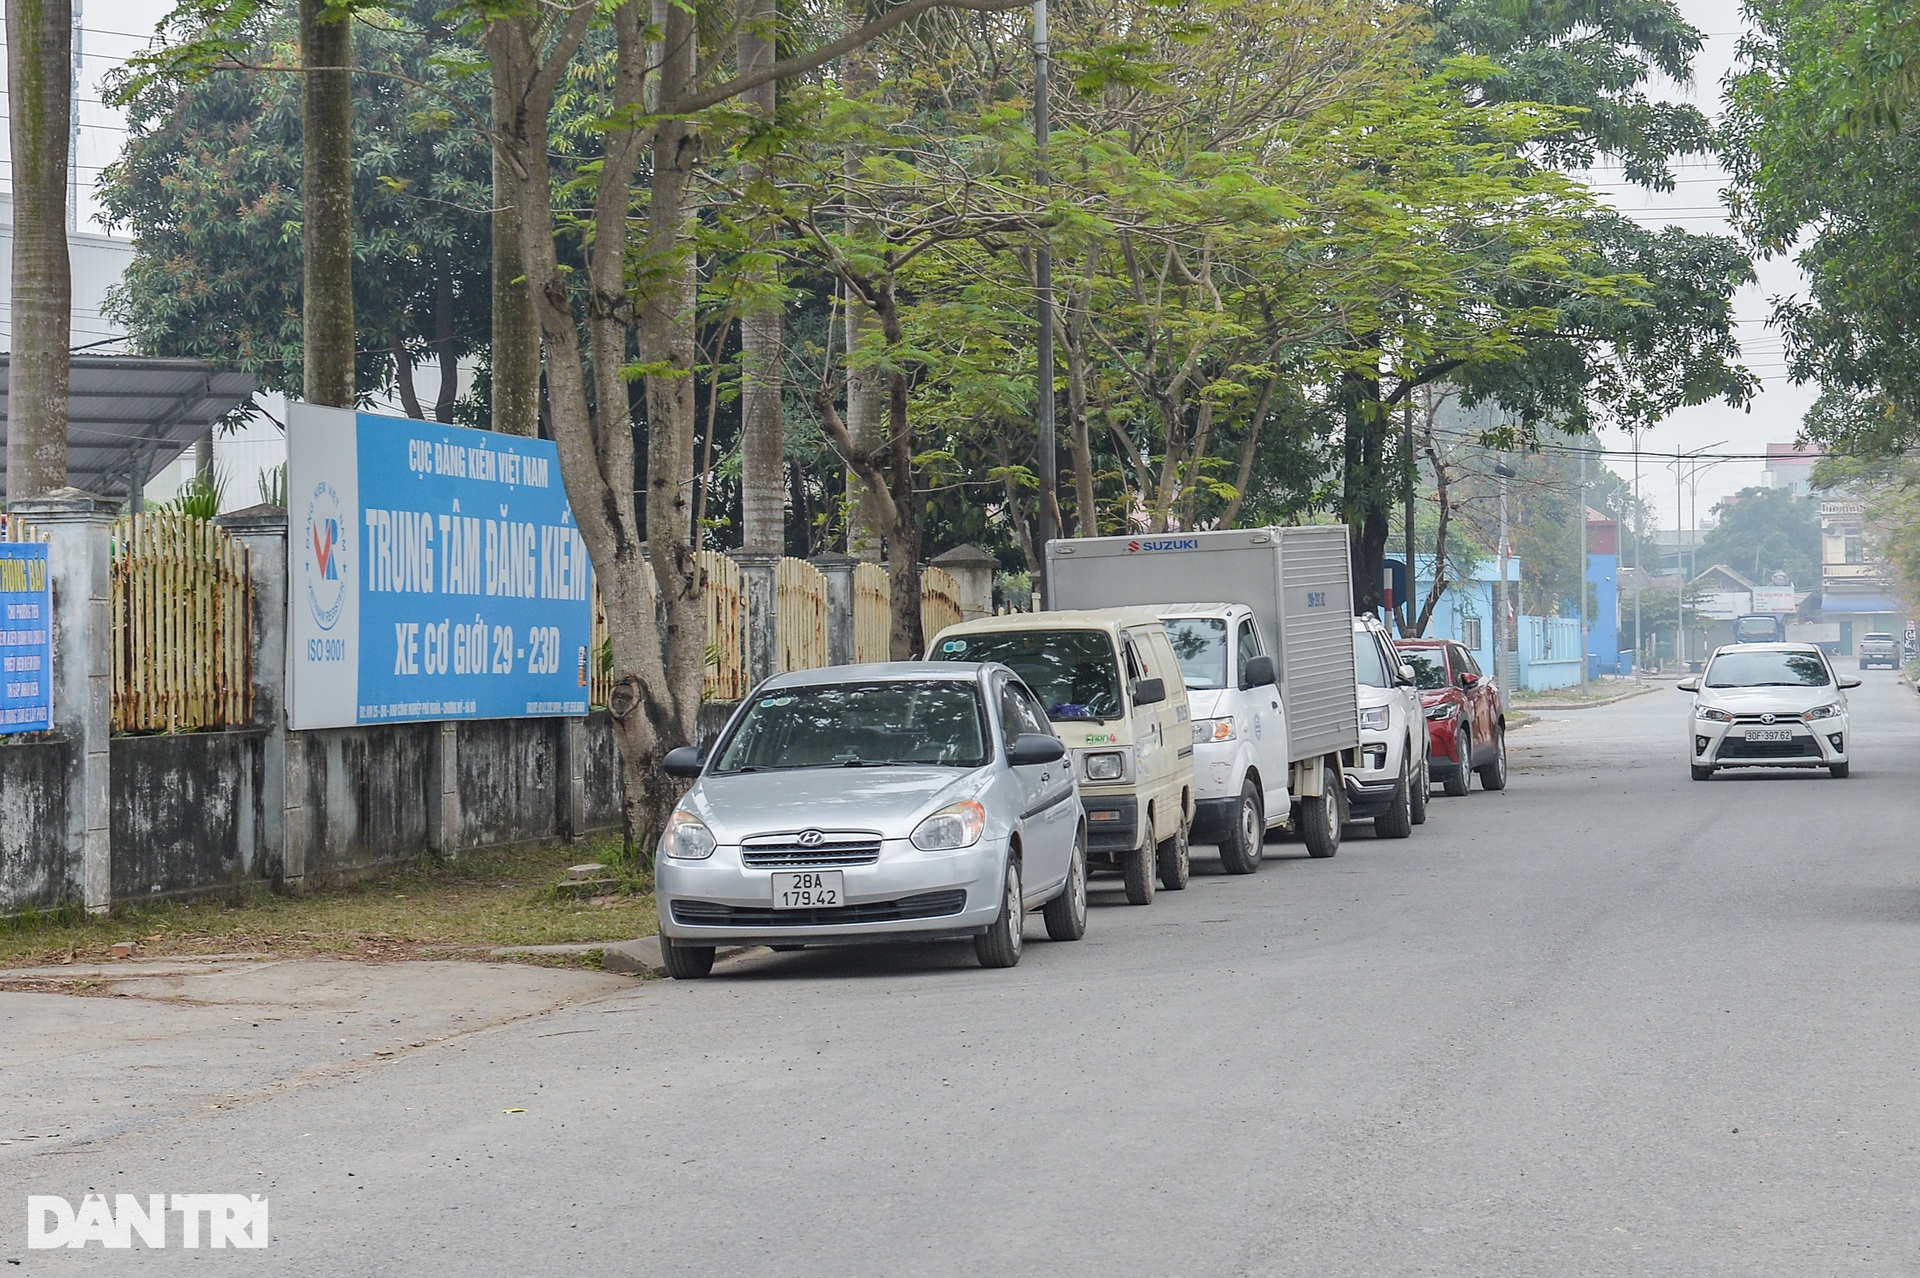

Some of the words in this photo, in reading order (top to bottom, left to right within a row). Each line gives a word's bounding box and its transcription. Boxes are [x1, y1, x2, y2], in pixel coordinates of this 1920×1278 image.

[408, 439, 432, 480] CỤC
[434, 437, 467, 478] ĐĂNG
[468, 436, 496, 482] KIỂM
[498, 447, 520, 491] VIỆT
[522, 456, 549, 488] NAM
[365, 508, 434, 593] TRUNG
[438, 498, 480, 596] TÂM
[485, 503, 536, 599] ĐĂNG
[540, 499, 587, 601] KIỂM
[1142, 539, 1198, 552] SUZUKI
[28, 551, 47, 592] BÁO
[307, 639, 323, 662] ISO
[325, 639, 345, 662] 9001
[394, 622, 419, 675] XE
[424, 618, 450, 675] CƠ
[453, 613, 489, 675] GIỚI
[492, 625, 514, 675] 29
[527, 626, 560, 674] 23D
[792, 873, 823, 889] 28A
[782, 890, 837, 906] 179.42
